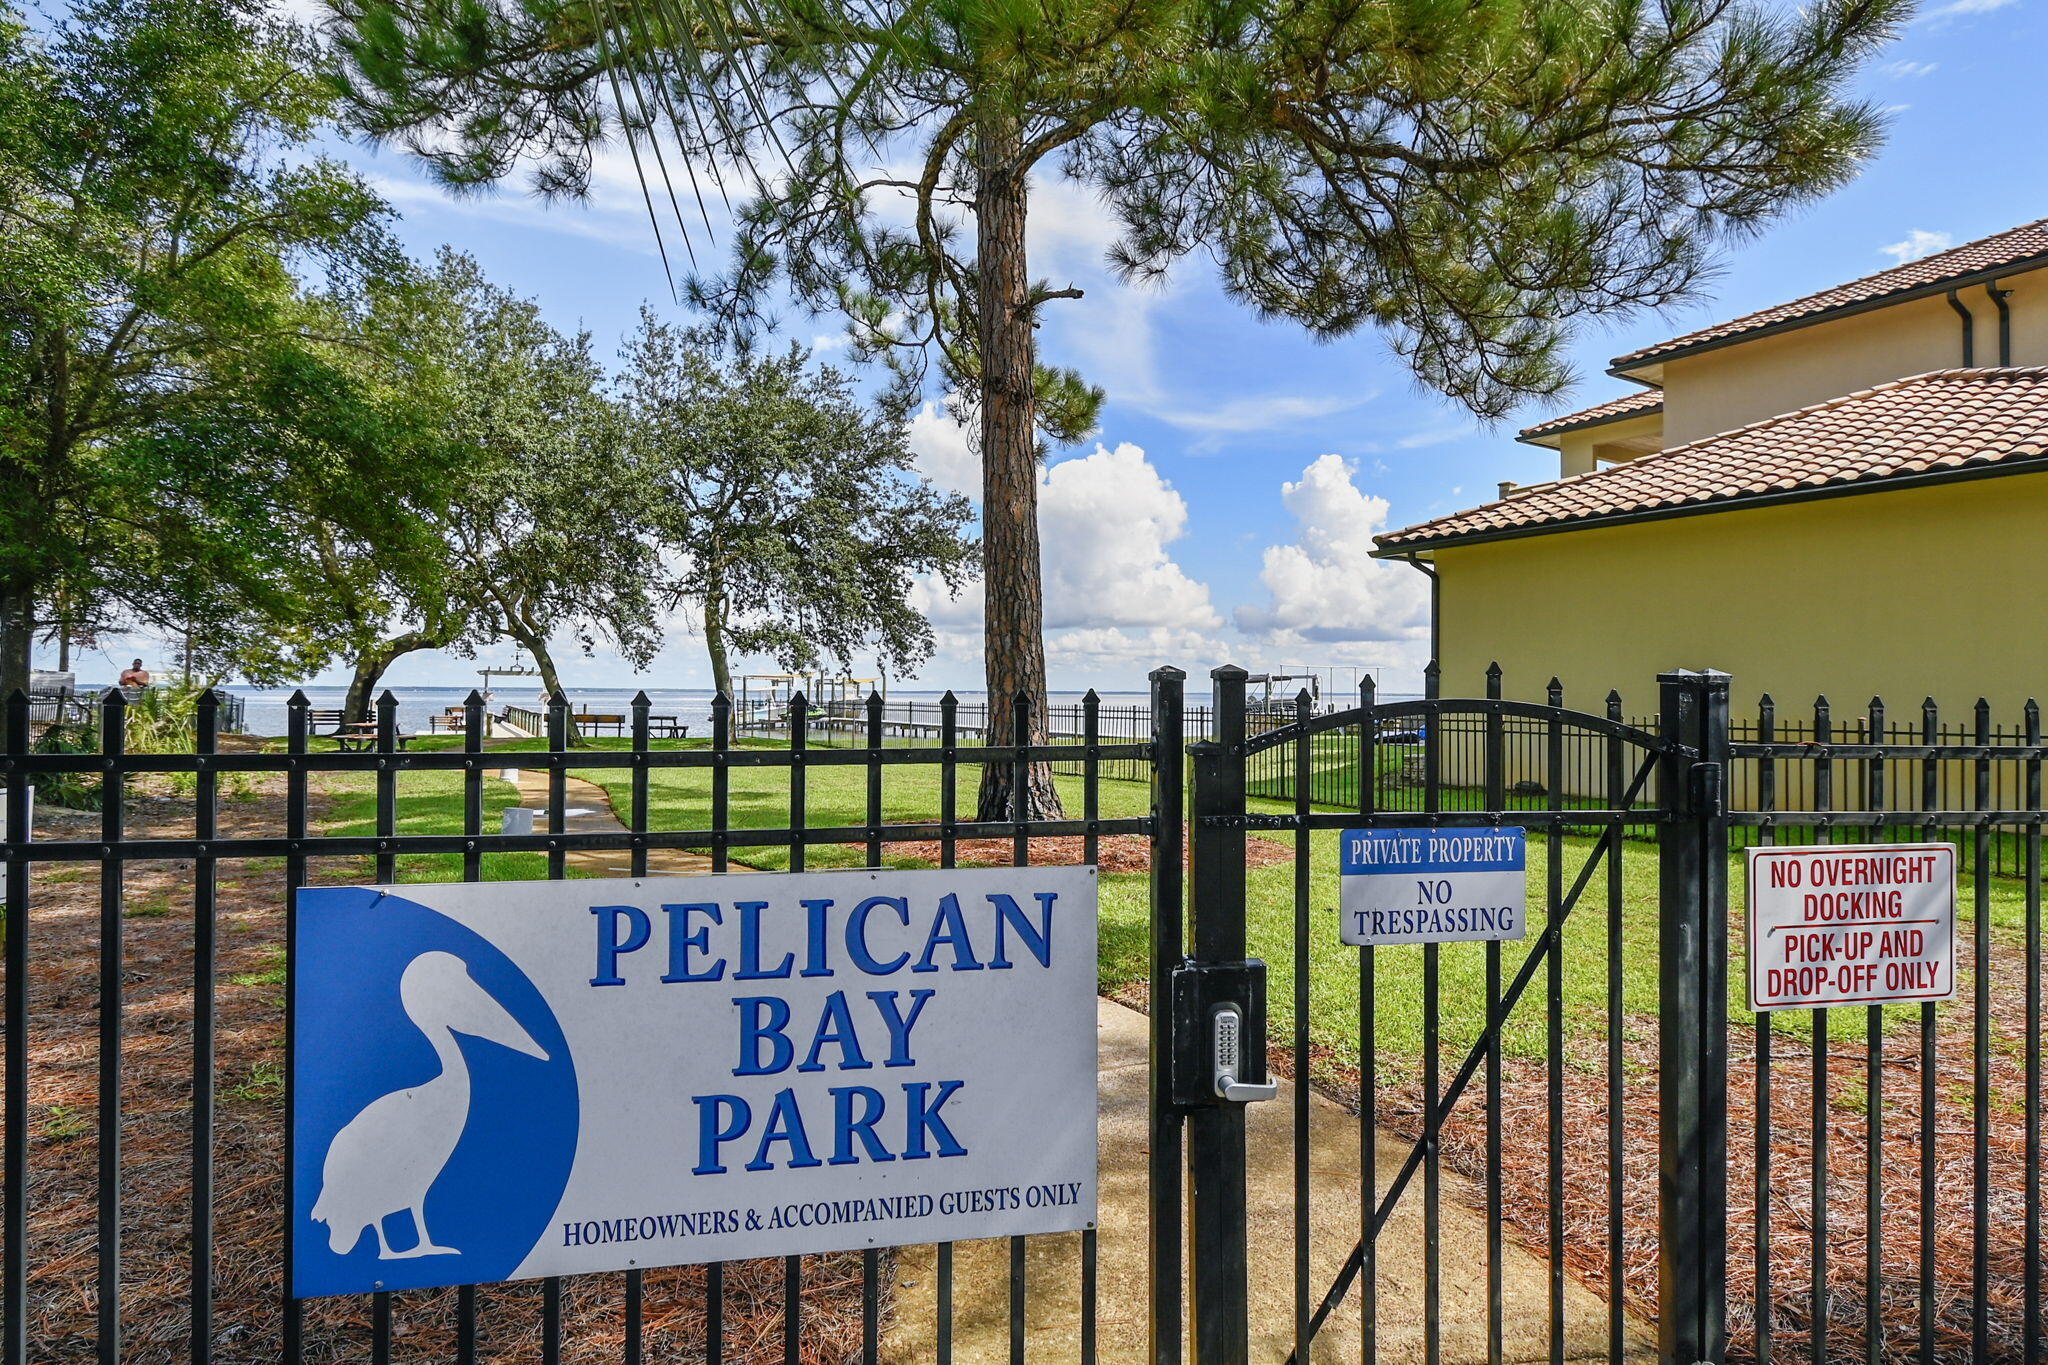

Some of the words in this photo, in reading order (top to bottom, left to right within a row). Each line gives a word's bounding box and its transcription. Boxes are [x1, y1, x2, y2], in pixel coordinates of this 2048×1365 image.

[1351, 838, 1422, 865] PRIVATE
[1428, 837, 1516, 863] PROPERTY
[1771, 860, 1802, 888] NO
[1811, 857, 1936, 887] OVERNIGHT
[1417, 880, 1452, 904] NO
[1804, 890, 1902, 921] DOCKING
[1354, 907, 1514, 935] TRESPASSING
[589, 892, 1058, 987] PELICAN
[1785, 932, 1873, 963] PICK-UP
[1879, 930, 1923, 958] AND
[1768, 964, 1877, 997] DROP-OFF
[1886, 961, 1939, 991] ONLY
[731, 988, 935, 1076] BAY
[691, 1080, 967, 1176] PARK
[562, 1209, 739, 1247] HOMEOWNERS
[744, 1208, 764, 1231] &
[767, 1193, 935, 1230] ACCOMPANIED
[938, 1187, 1021, 1217] GUESTS
[1025, 1183, 1082, 1210] ONLY
